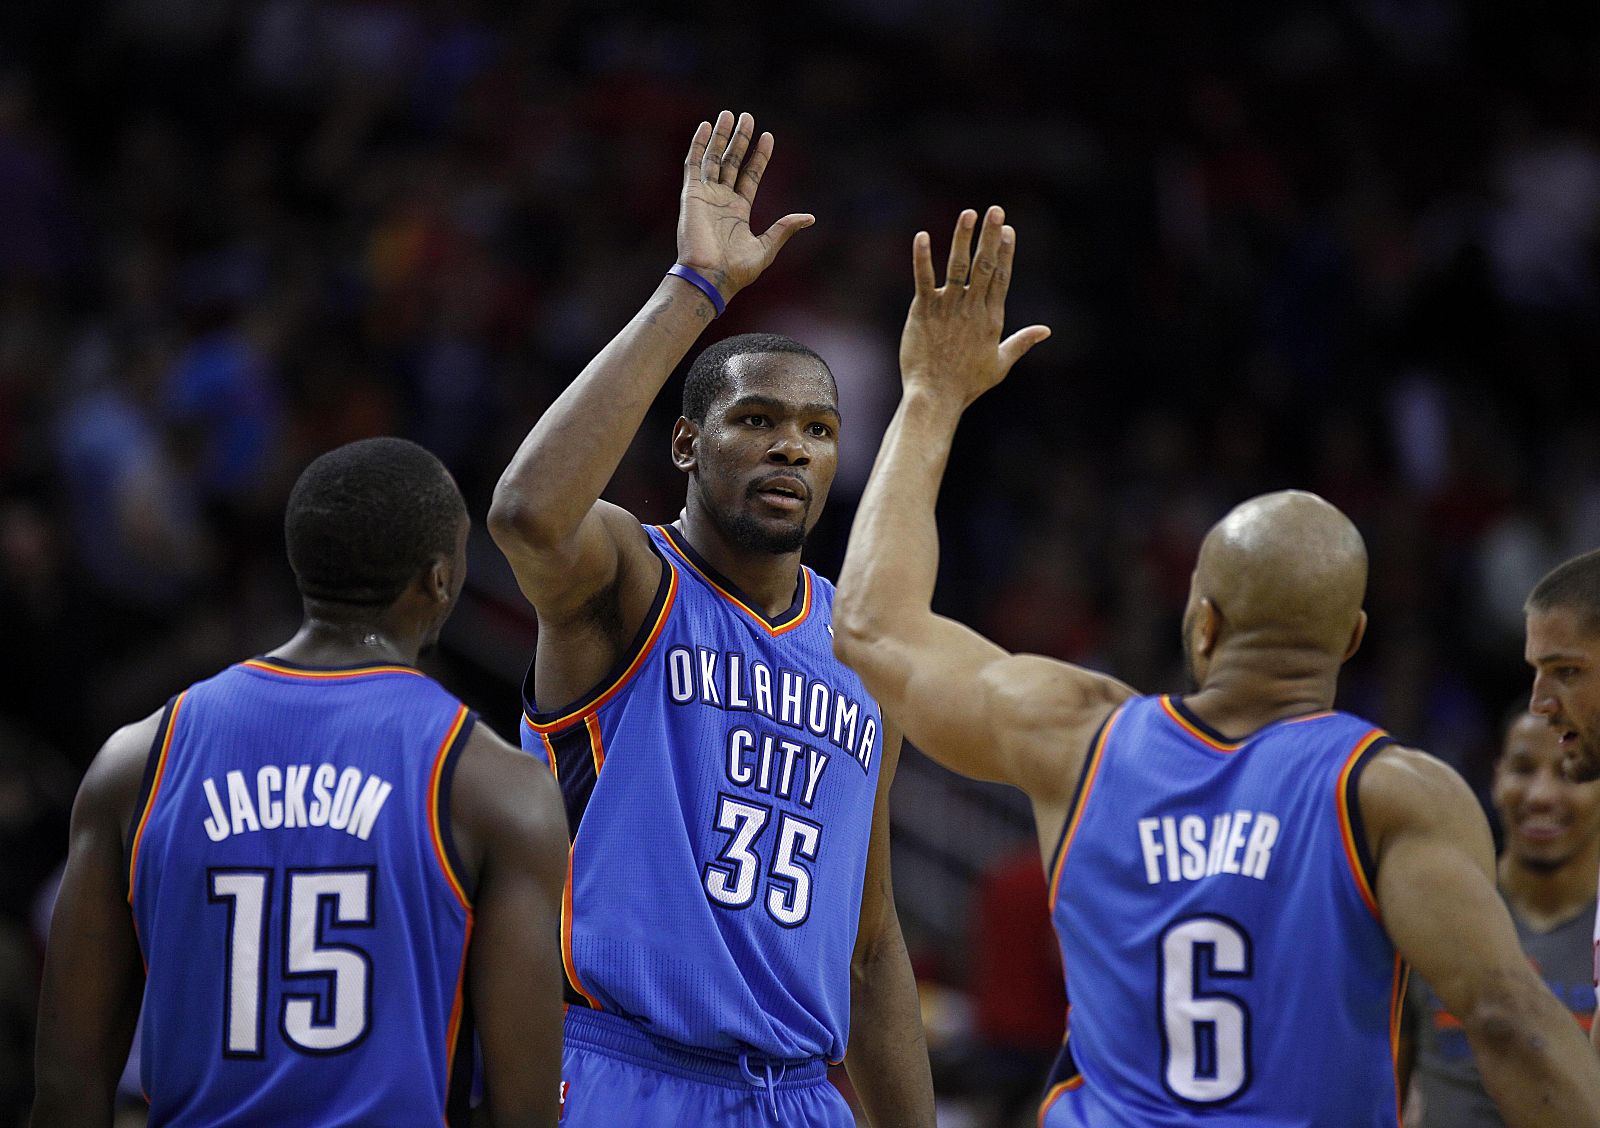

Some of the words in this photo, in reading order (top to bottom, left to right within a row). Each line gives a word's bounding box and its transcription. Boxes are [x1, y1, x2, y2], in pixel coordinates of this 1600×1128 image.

[665, 644, 876, 776] OKLAHOMA
[725, 725, 831, 809] CITY
[202, 762, 393, 842] JACKSON
[701, 791, 823, 929] 35
[1137, 809, 1280, 884] FISHER
[206, 864, 377, 1061] 15
[1158, 912, 1252, 1107] 6
